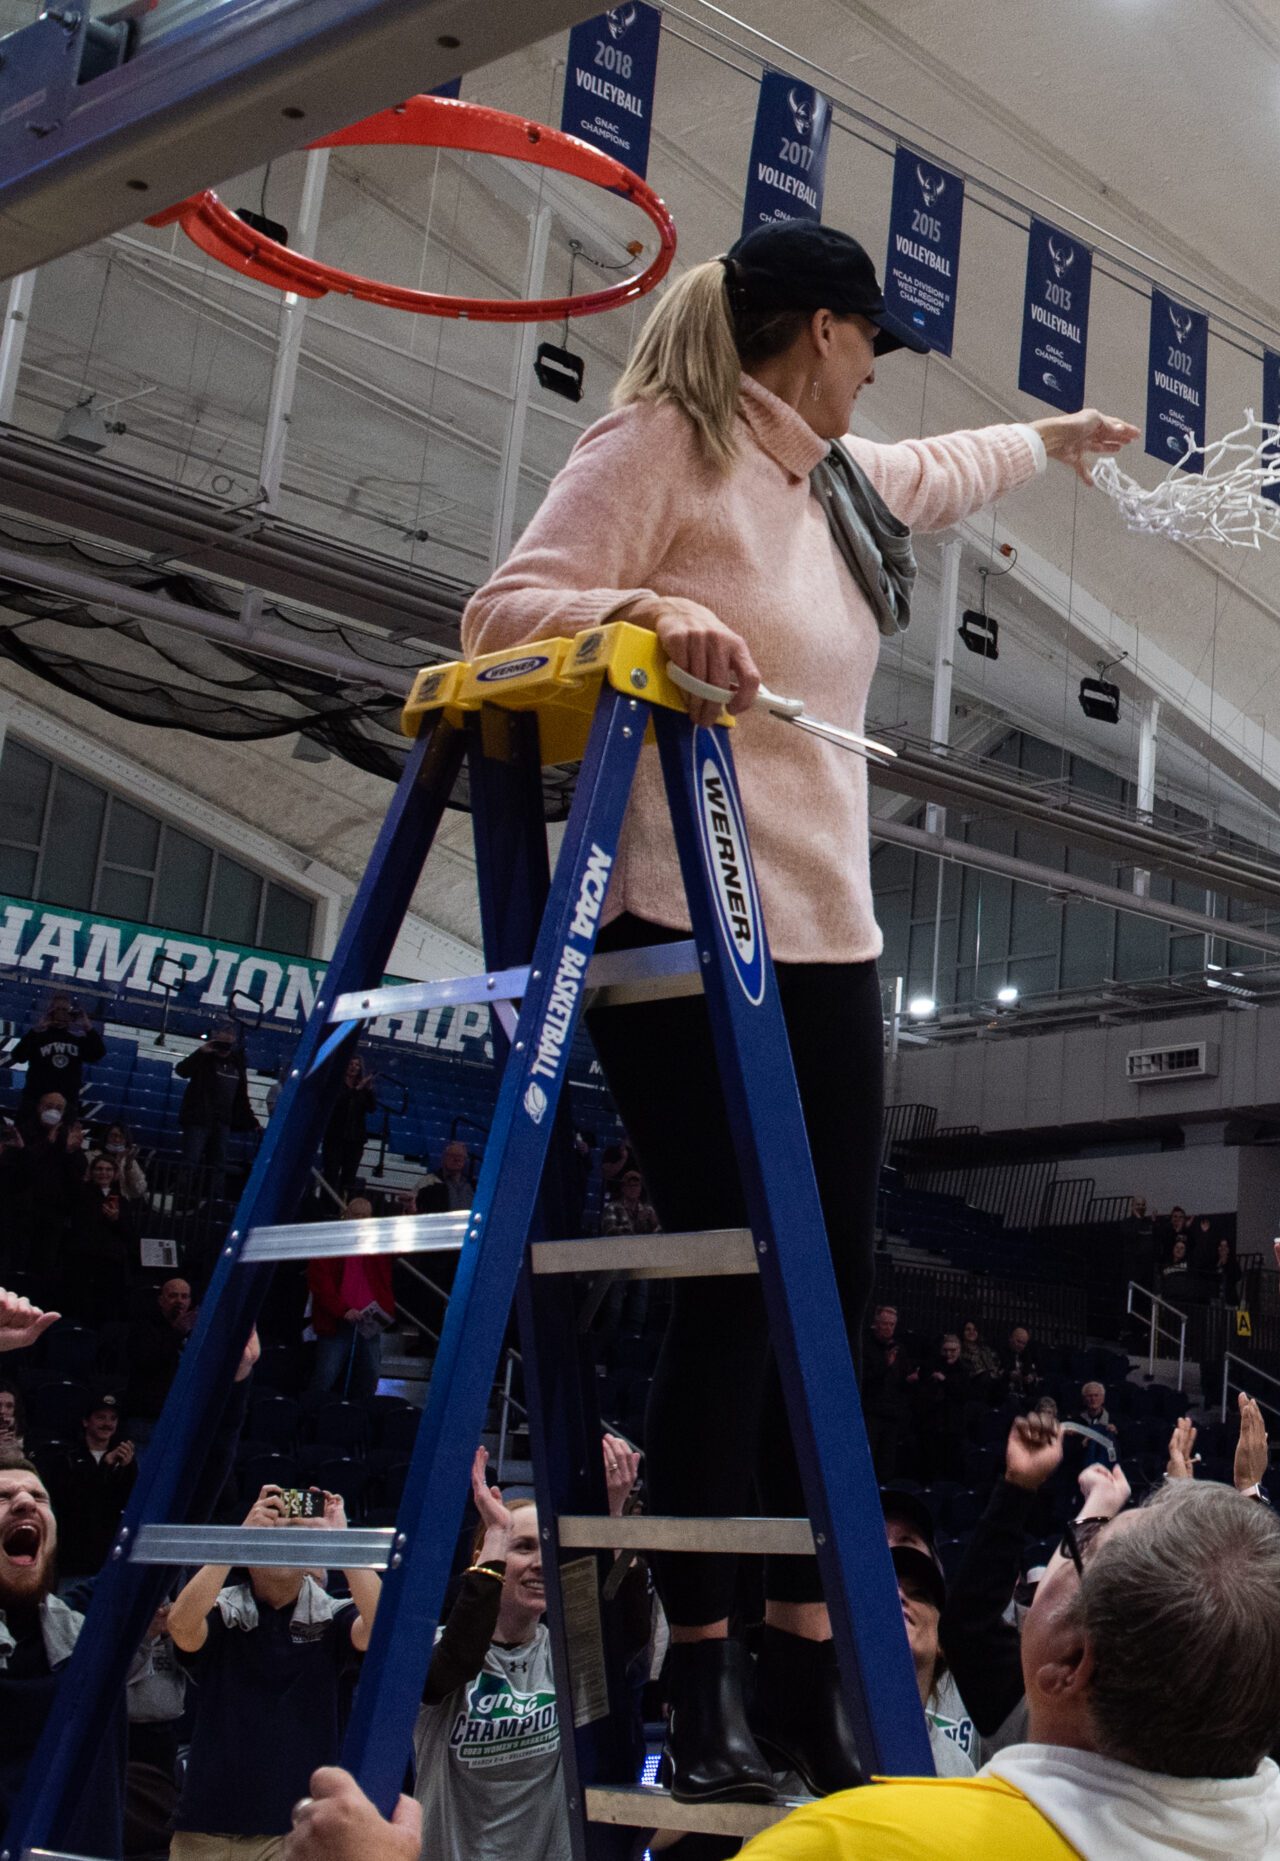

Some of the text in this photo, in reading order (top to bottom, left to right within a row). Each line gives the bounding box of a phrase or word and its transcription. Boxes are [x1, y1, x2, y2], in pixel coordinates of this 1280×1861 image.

[594, 40, 632, 79] 2018
[576, 67, 643, 118] VOLLEYBALL
[580, 119, 631, 150] CHAMPIONS
[594, 116, 619, 134] GNAC
[778, 137, 815, 172] 2017
[758, 163, 817, 209] VOLLEYBALL
[774, 208, 796, 221] GNA
[911, 208, 941, 241] 2015
[895, 234, 951, 278] VOLLEYBALL
[1045, 280, 1072, 312] 2013
[1031, 303, 1081, 344] VOLLEYBALL
[1034, 348, 1072, 373] CHAMPIONS
[1045, 344, 1065, 360] GNAC
[1168, 346, 1193, 377] 2012
[1154, 370, 1200, 407] VOLLEYBALL
[490, 660, 537, 678] WERNER
[704, 776, 752, 944] WERNER
[532, 842, 612, 1079] NCAA BASKETBALL
[1239, 1315, 1249, 1331] A
[476, 1693, 538, 1714] gnac
[450, 1705, 558, 1746] CHAMPIO
